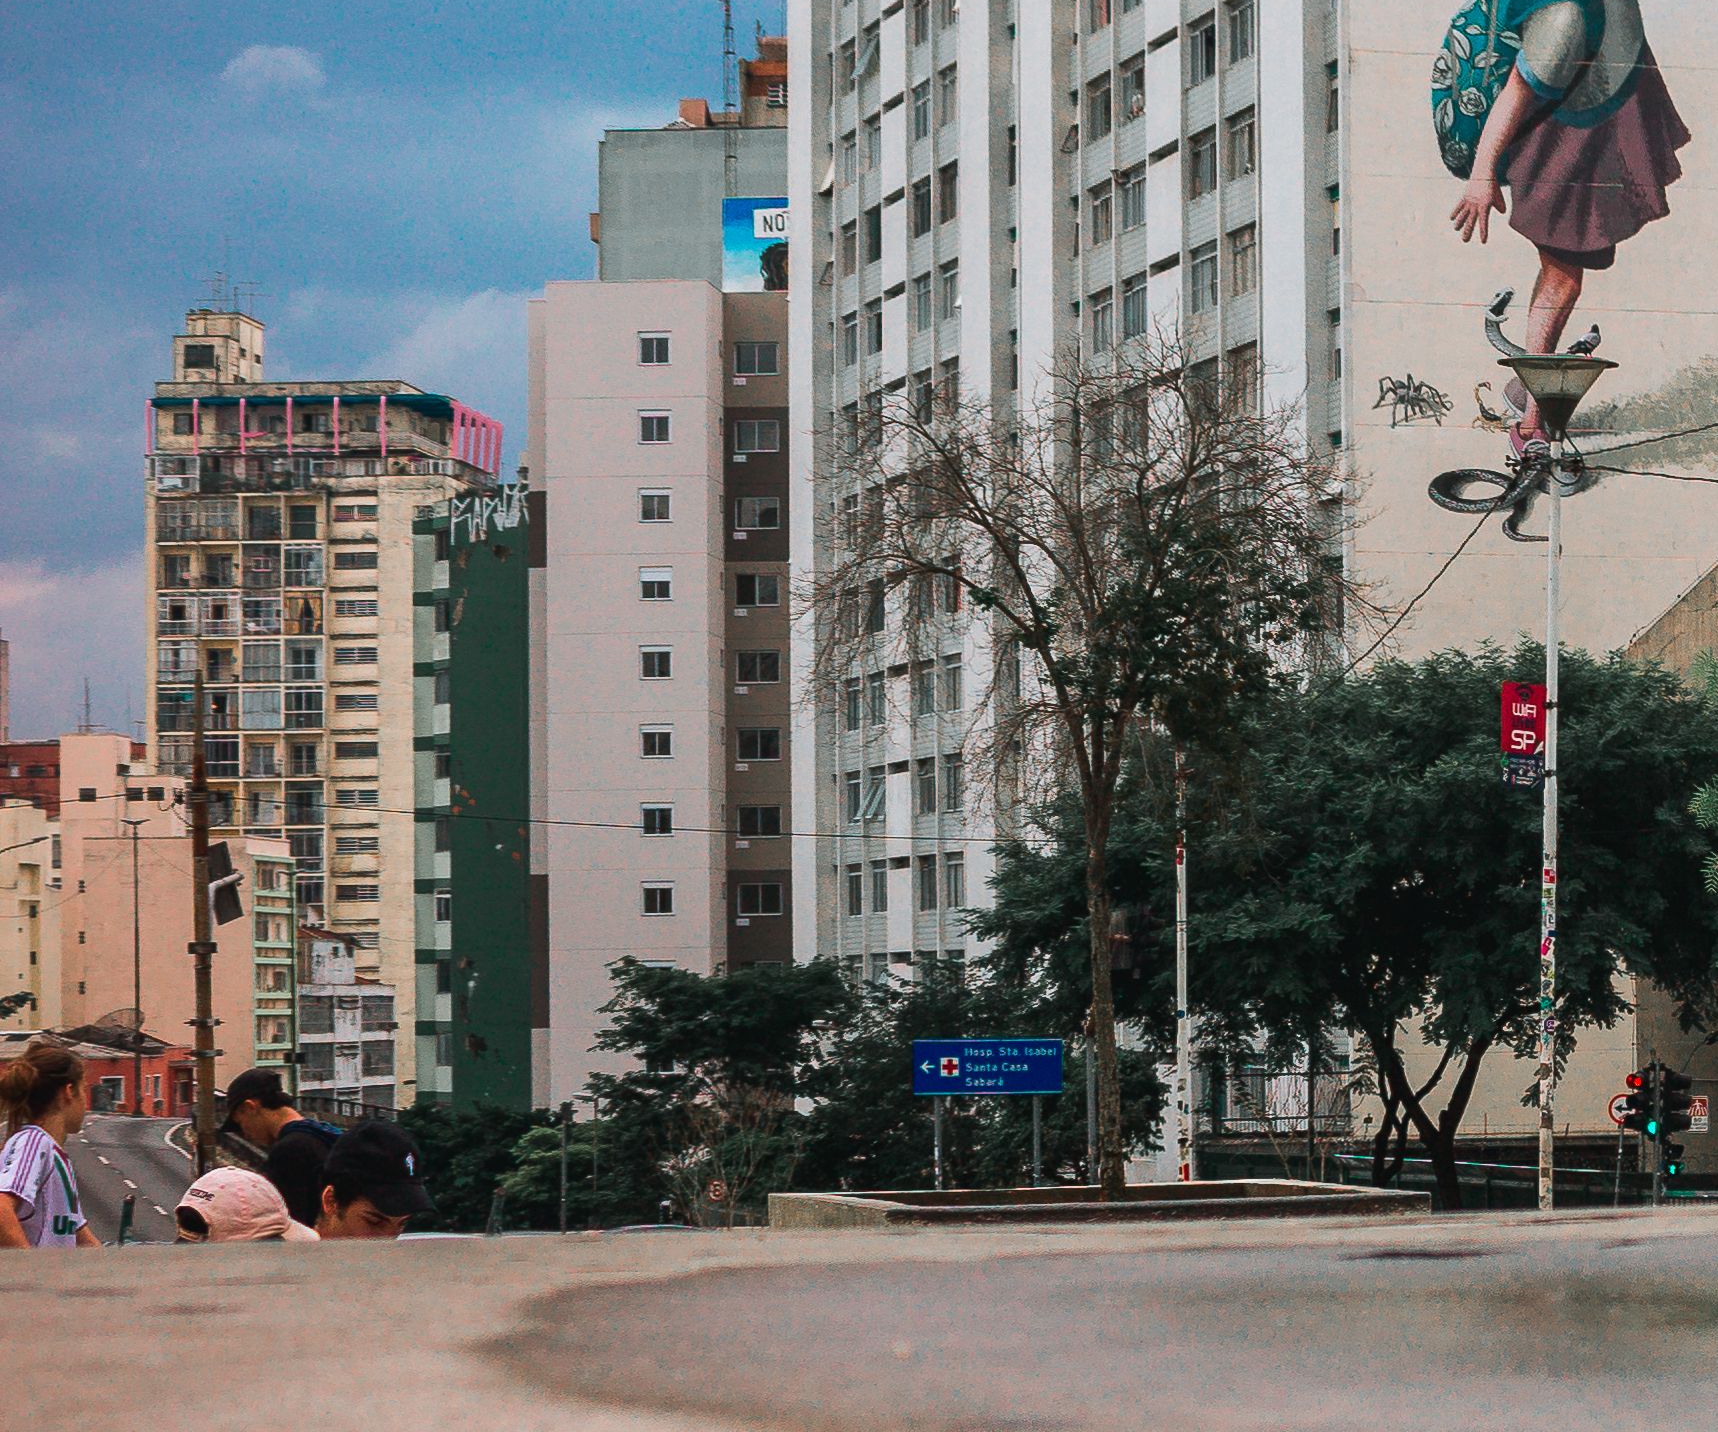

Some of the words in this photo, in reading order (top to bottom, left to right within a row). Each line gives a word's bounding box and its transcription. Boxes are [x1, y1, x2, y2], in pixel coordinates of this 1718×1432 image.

[763, 211, 790, 233] NO
[1511, 729, 1536, 750] SP
[964, 1047, 994, 1057] Hosp.
[999, 1047, 1021, 1056] Sta.
[1024, 1046, 1057, 1056] Isabel
[965, 1062, 998, 1072] Santa
[1001, 1062, 1029, 1072] Casa
[965, 1077, 1004, 1087] Sabará
